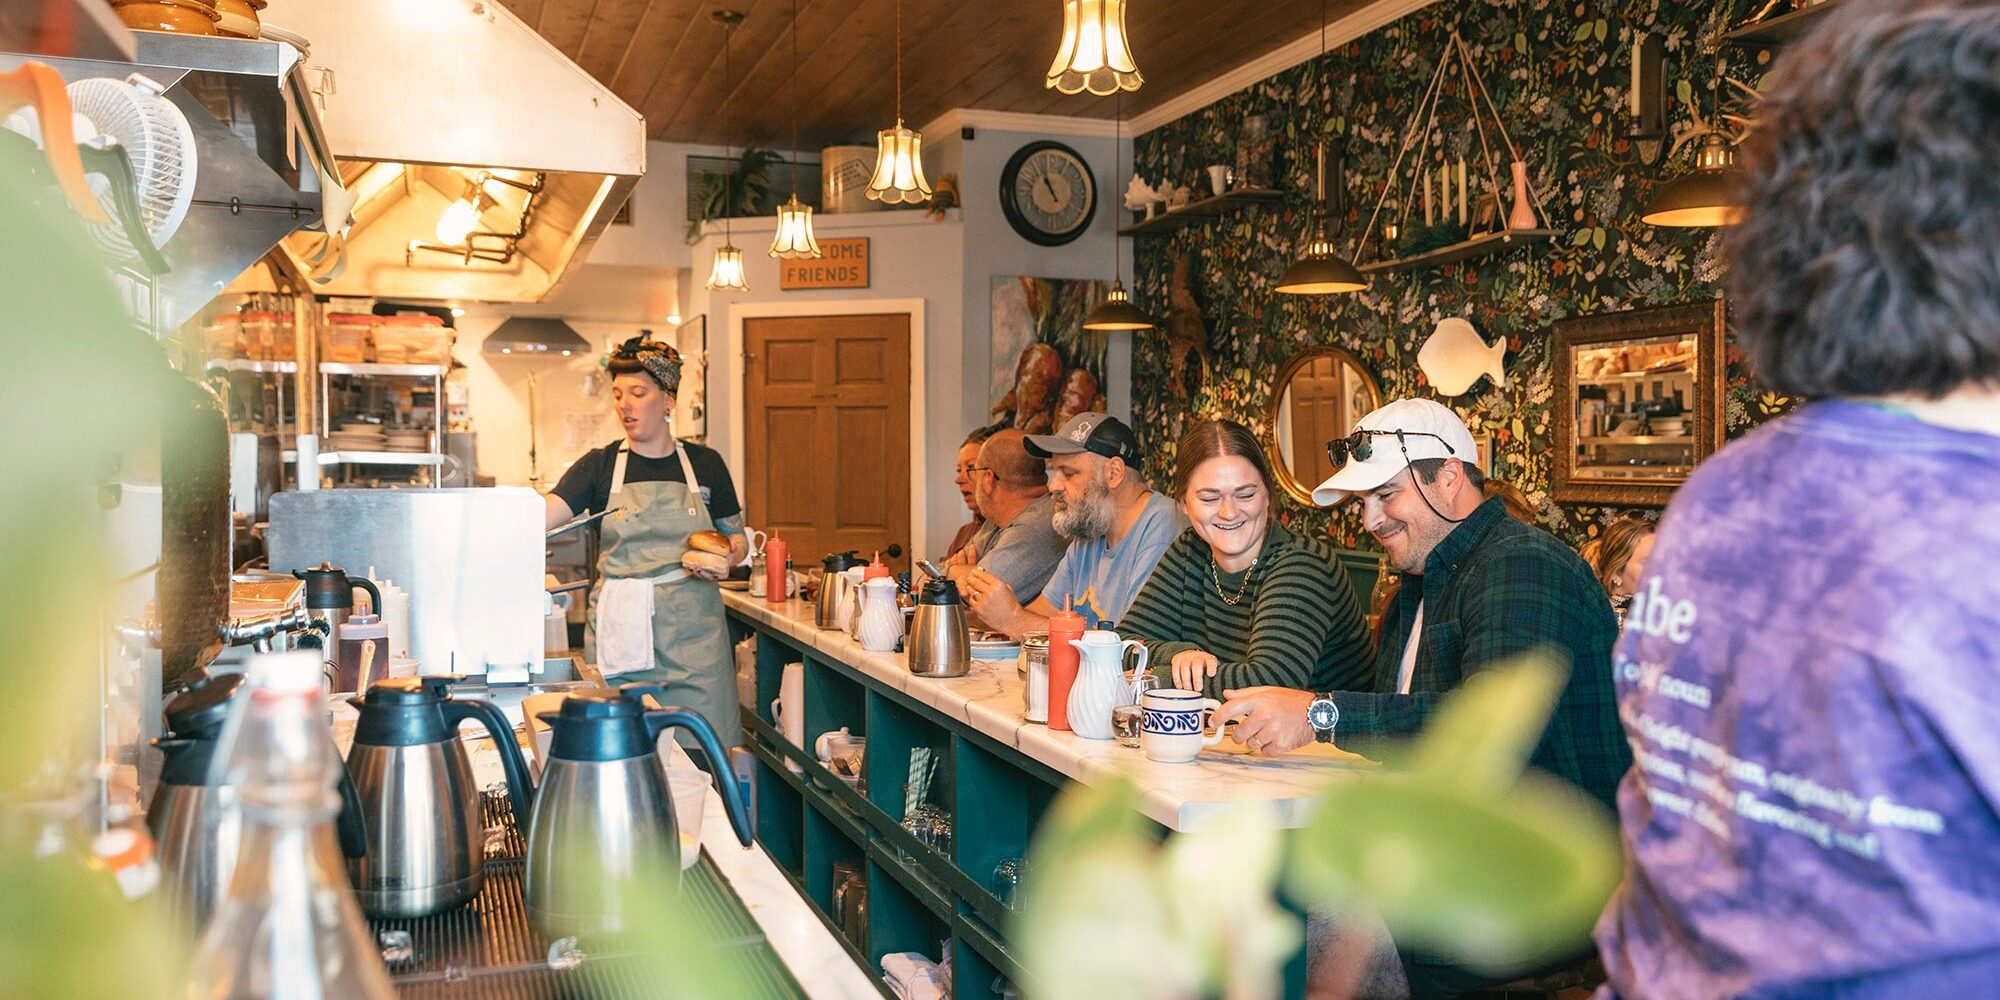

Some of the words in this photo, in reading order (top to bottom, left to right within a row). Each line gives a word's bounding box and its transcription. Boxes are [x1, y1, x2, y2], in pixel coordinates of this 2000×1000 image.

[787, 266, 859, 282] FRIENDS
[1770, 771, 1864, 823] originally
[1868, 795, 1943, 836] from
